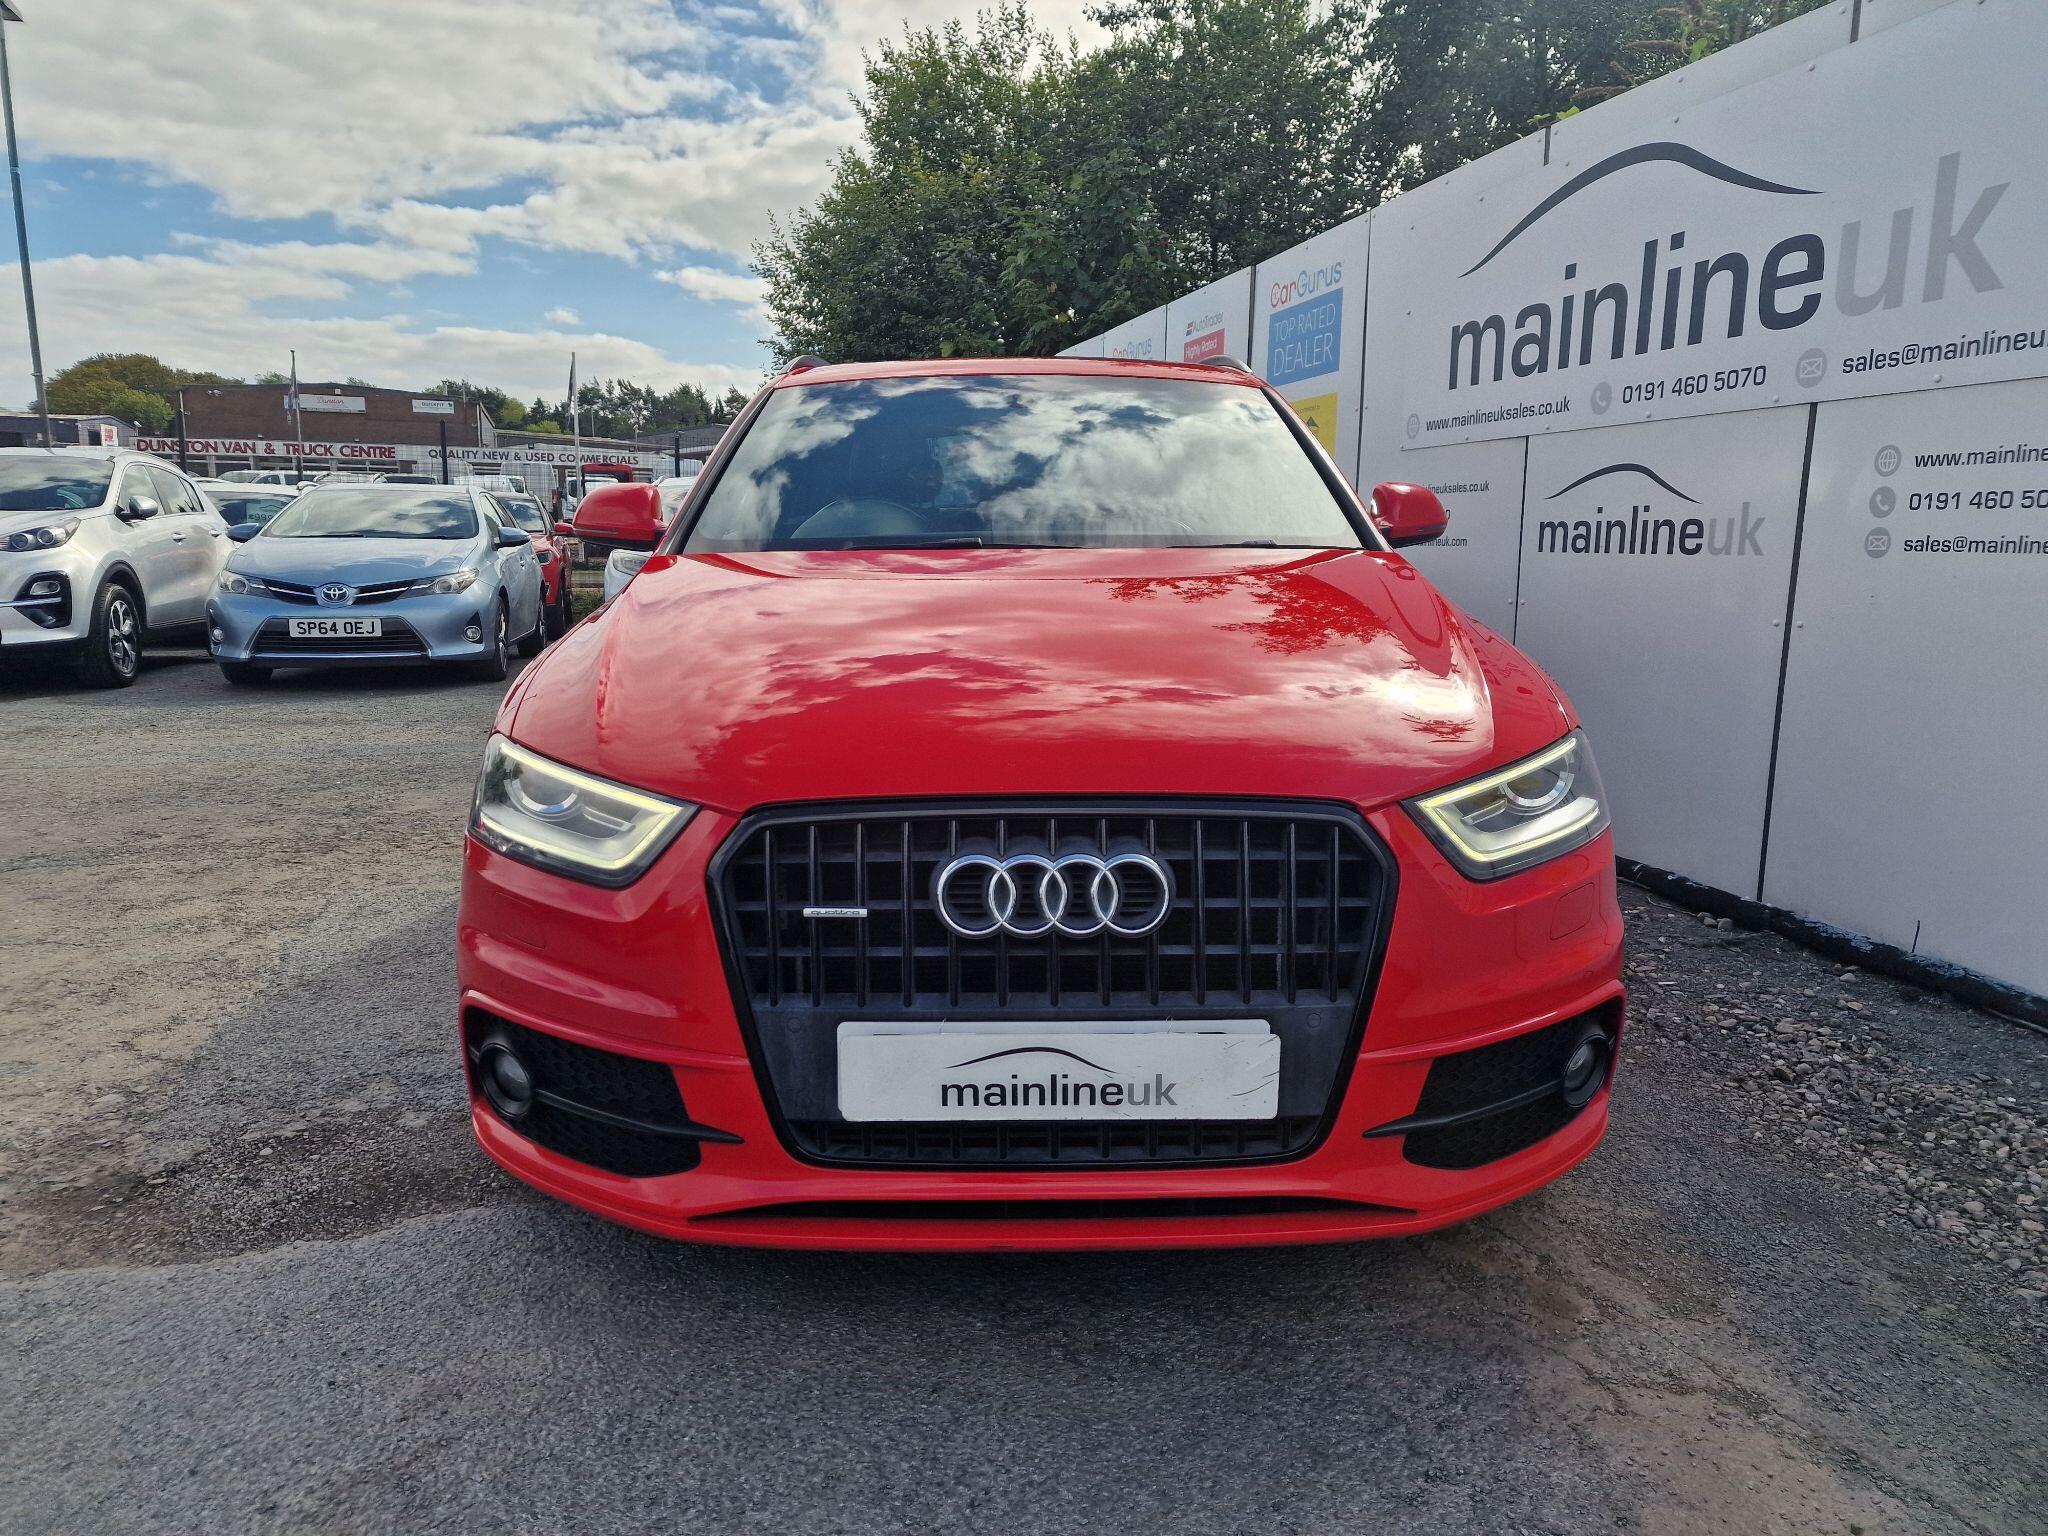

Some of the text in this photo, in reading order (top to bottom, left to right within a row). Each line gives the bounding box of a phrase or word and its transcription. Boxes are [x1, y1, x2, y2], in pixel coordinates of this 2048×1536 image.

[1270, 261, 1342, 309] CarGurus
[1448, 151, 2012, 390] mainlineuk
[1275, 303, 1336, 343] TOP RATED
[1201, 337, 1218, 353] Rated
[1273, 332, 1333, 377] DEALER
[1842, 329, 2048, 374] sales@mainlineu
[1622, 365, 1767, 404] 0191 460 5070
[1426, 395, 1570, 431] www.mainlineuksales.co.uk
[136, 438, 396, 458] DUNSTON VAN & TRUCK CENTRE
[428, 449, 639, 465] QUALITY NEW & USED COMMERCIALS
[1909, 490, 2048, 511] 0191 460 50
[1538, 501, 1767, 556] mainlineuk
[296, 622, 339, 635] SP64
[941, 1074, 1178, 1107] mainlineuk
